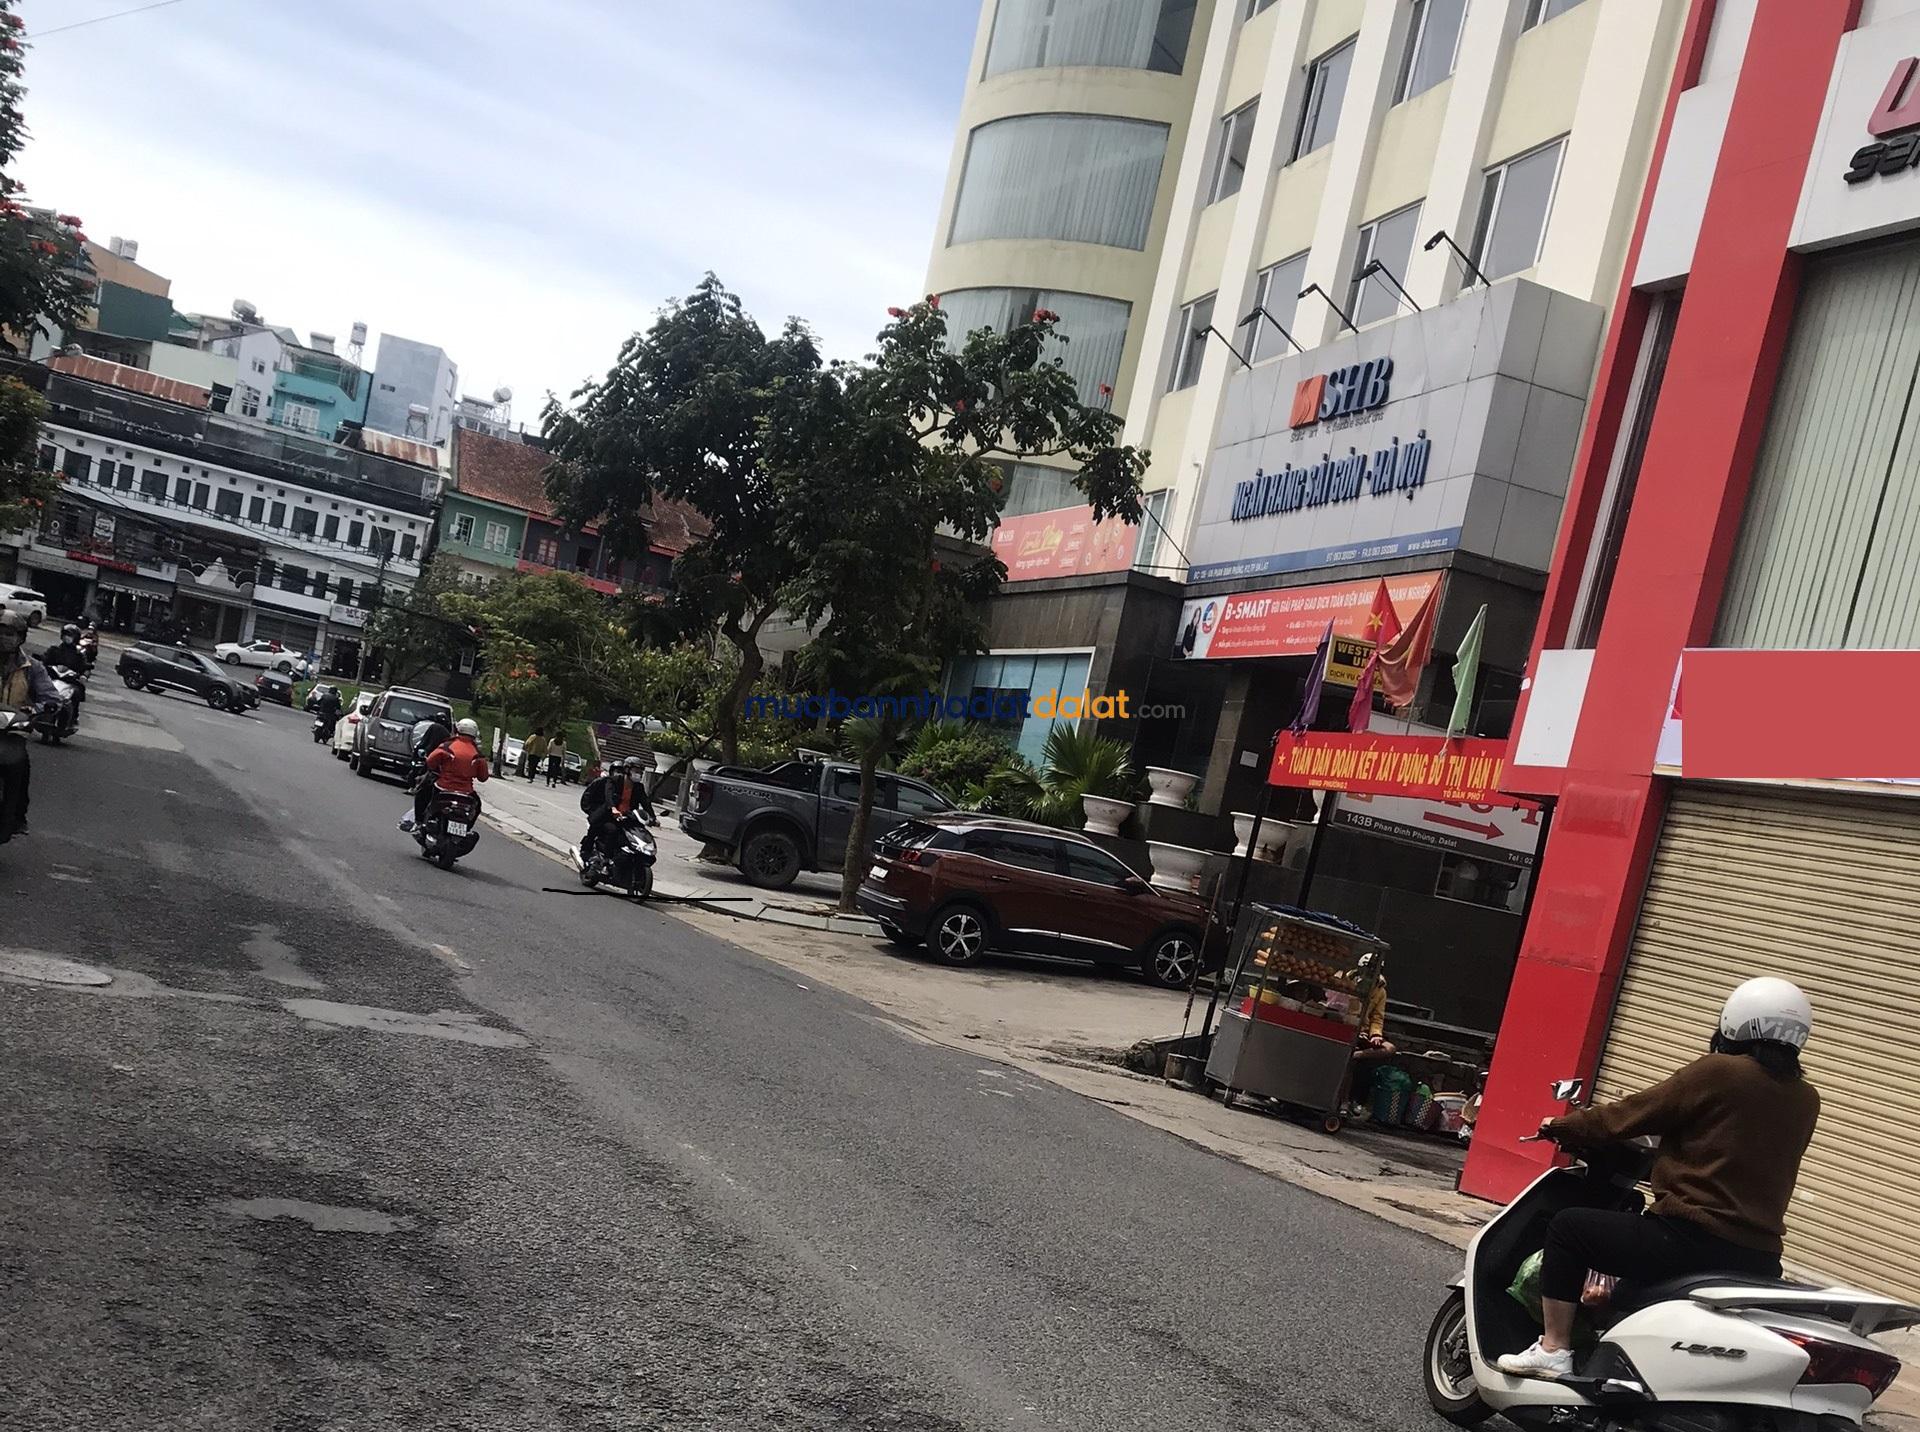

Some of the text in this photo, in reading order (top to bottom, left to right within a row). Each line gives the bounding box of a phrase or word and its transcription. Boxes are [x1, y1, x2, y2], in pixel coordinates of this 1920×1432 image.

[1319, 356, 1394, 422] SHB
[1231, 467, 1272, 522] NGÂN
[1266, 462, 1308, 516] HÀNG
[1303, 452, 1336, 508] SÀI
[1329, 446, 1368, 504] GÒN
[1370, 435, 1399, 497] HÀ
[1394, 428, 1432, 502] NỘI
[1225, 598, 1272, 620] B-SMART
[1289, 740, 1314, 775] TOÀN
[1311, 742, 1333, 777] DÂN
[1330, 743, 1359, 779] ĐOÀN
[1355, 740, 1379, 780] KẾT
[1375, 745, 1400, 782] XÂY
[1445, 755, 1467, 791] THỊ
[1466, 750, 1493, 789] VĂN
[1346, 813, 1373, 828] 143B
[1373, 821, 1393, 832] Phan
[1508, 853, 1519, 862] Tel
